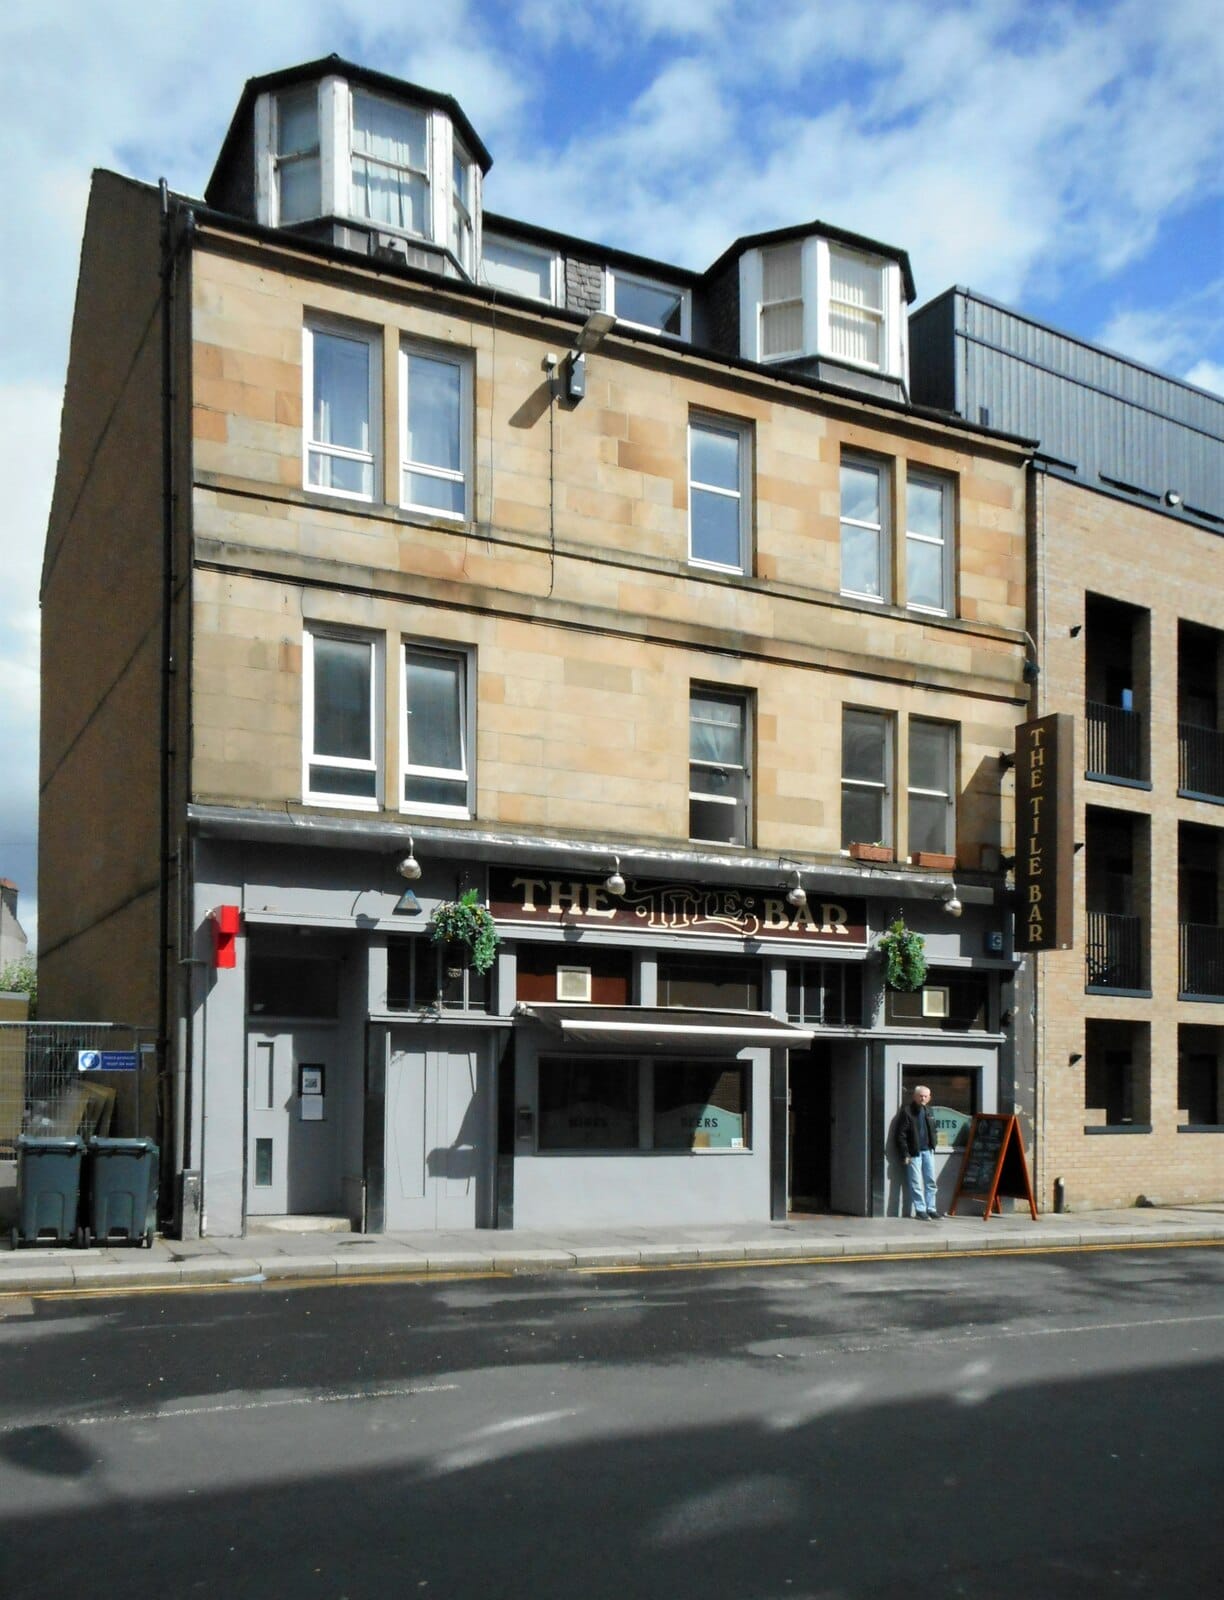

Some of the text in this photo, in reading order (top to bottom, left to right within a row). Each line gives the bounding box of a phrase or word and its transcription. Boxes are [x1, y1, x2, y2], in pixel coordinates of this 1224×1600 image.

[1028, 727, 1045, 943] THE TILE BAR
[511, 878, 849, 935] THE TILE BAR
